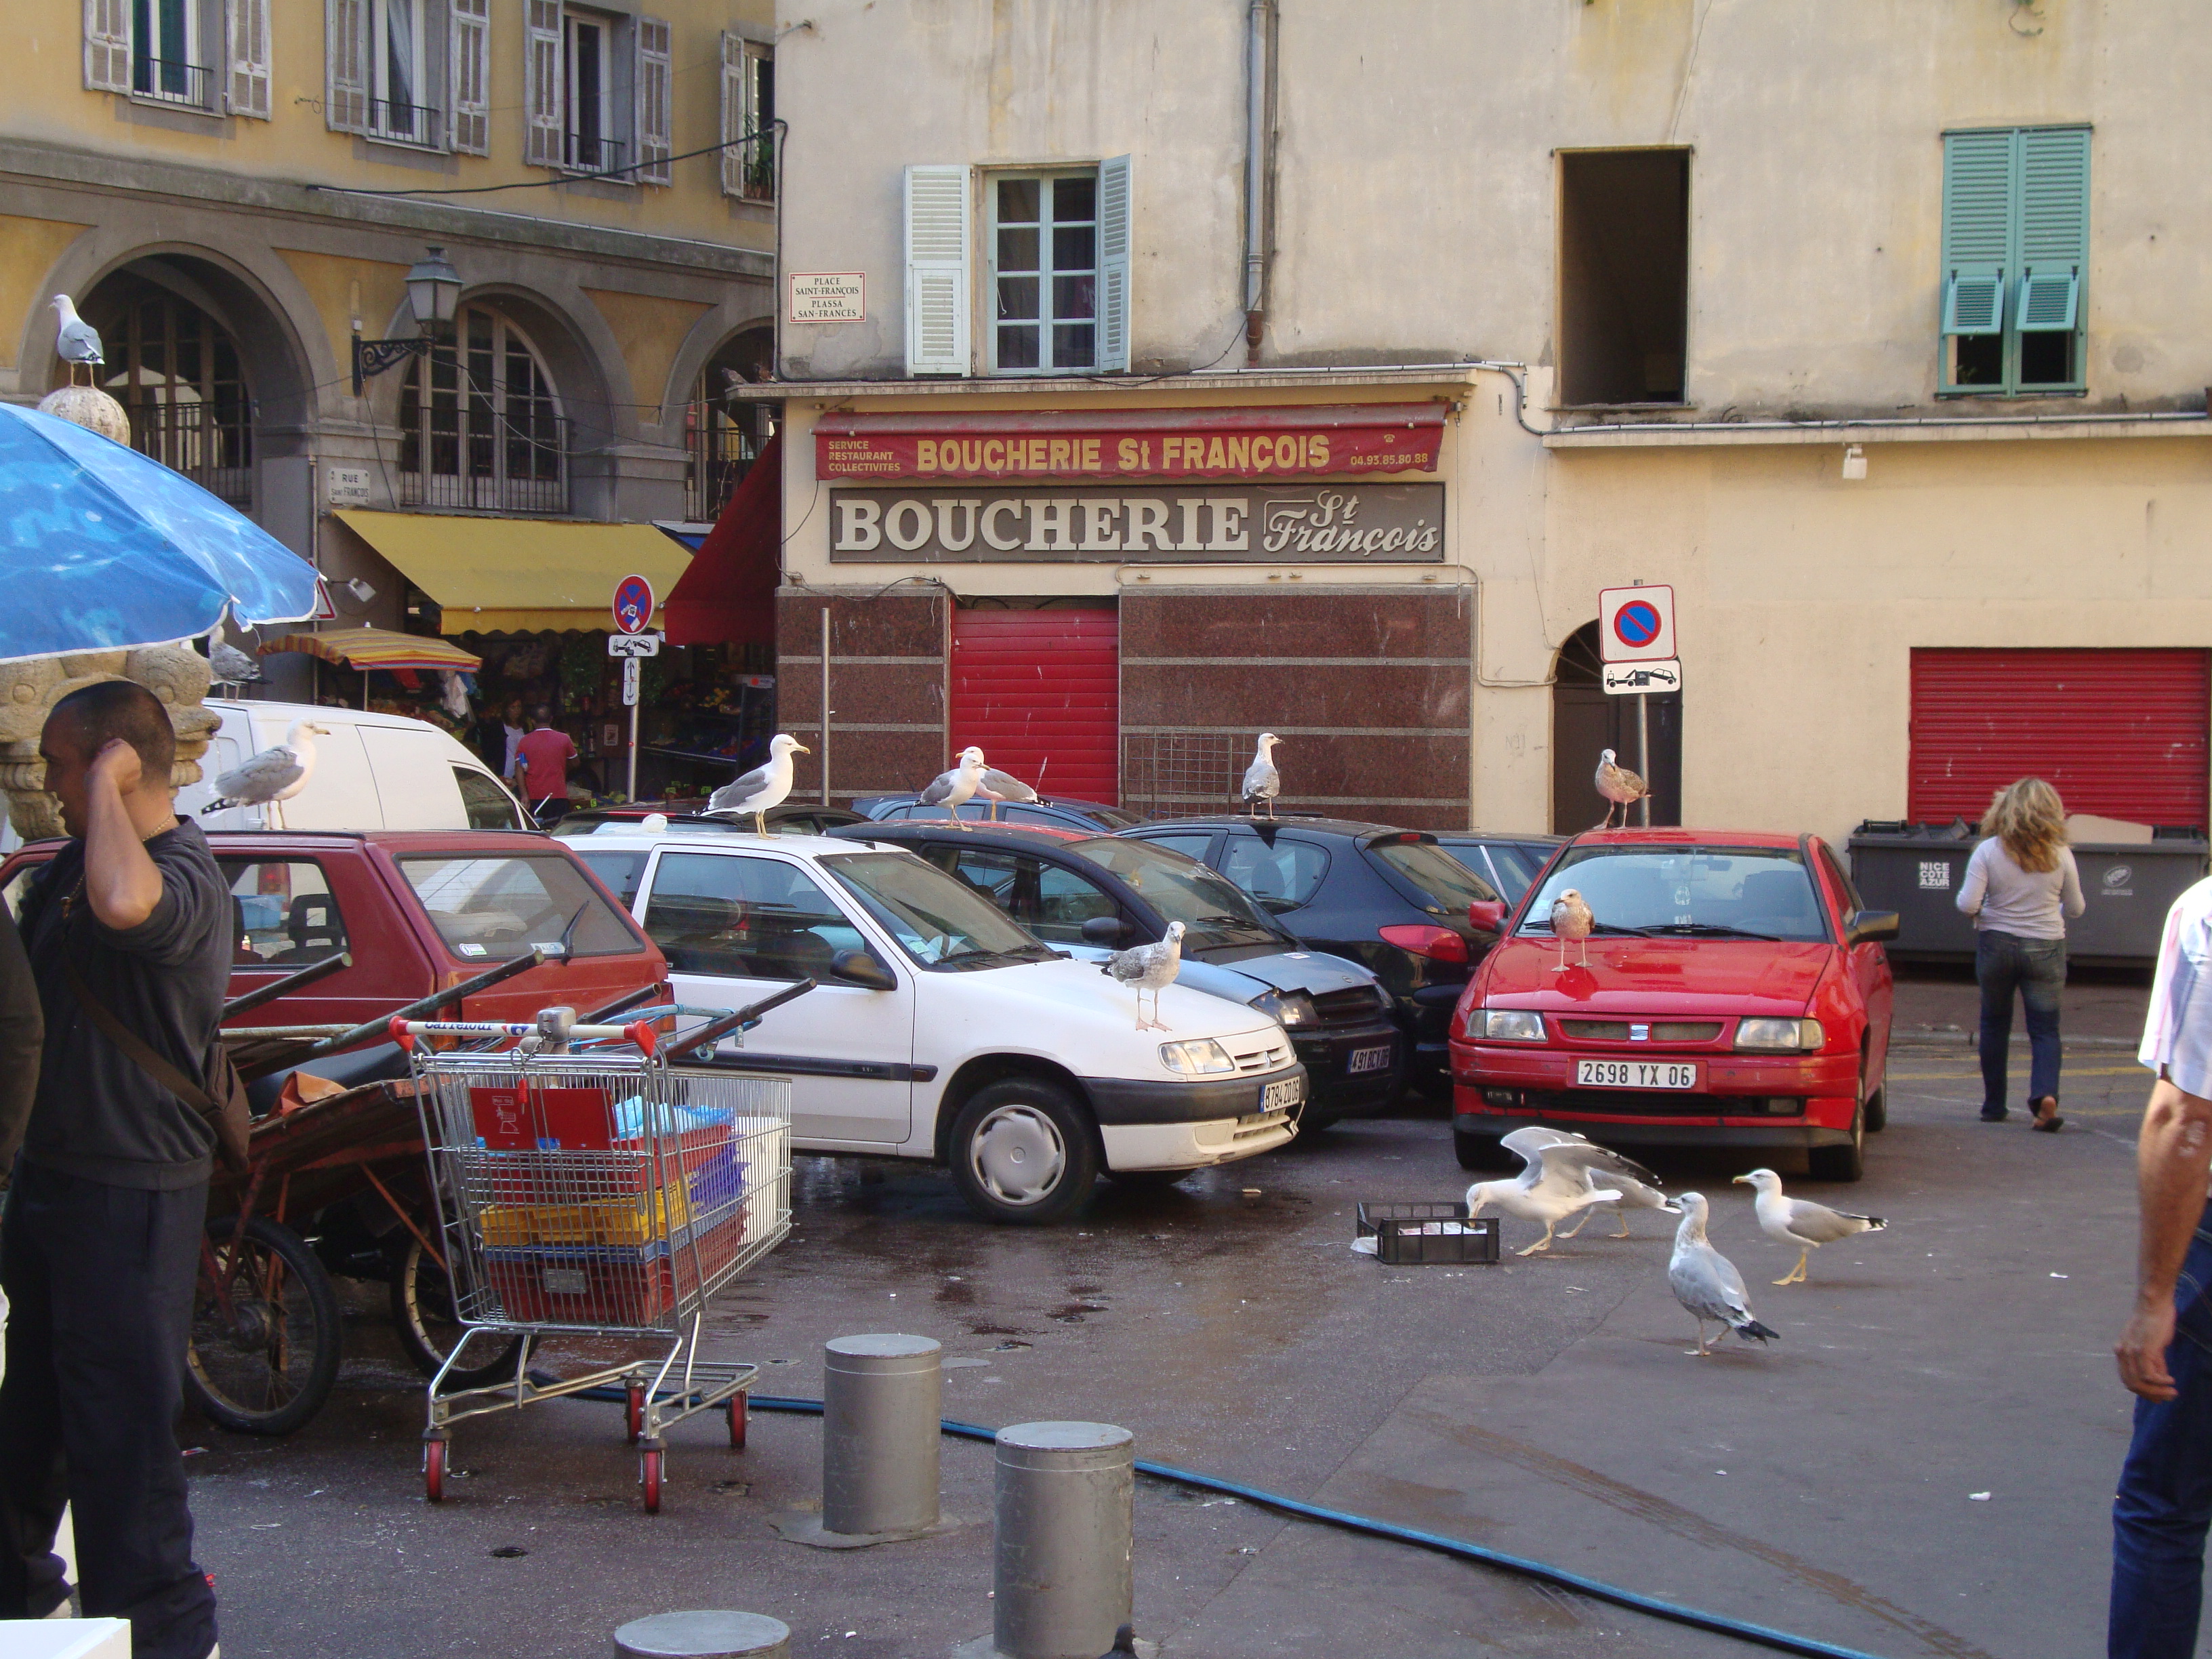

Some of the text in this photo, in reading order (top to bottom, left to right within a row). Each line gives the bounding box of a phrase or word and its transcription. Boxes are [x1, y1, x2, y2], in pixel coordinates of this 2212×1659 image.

[814, 277, 840, 285] PLACE
[795, 286, 859, 296] SAINT-FRANÇOIS
[812, 300, 843, 308] PLASSA
[798, 308, 857, 318] SAN-FRANCÈS
[828, 441, 869, 450] SERVICE
[828, 451, 894, 461] RESTAURANT
[917, 434, 1330, 473] BOUCHERIE St FRANÇOIS
[1350, 452, 1429, 466] 04.93.85.80.88
[828, 462, 901, 472] COLLECTIVITES
[342, 473, 359, 483] RUE
[834, 489, 1360, 552] BOUCHERIE St
[1263, 508, 1439, 556] François
[1919, 861, 1950, 871] NICE
[1919, 870, 1950, 879] COTE
[1919, 878, 1950, 886] AZUR
[1352, 1051, 1367, 1069] 491
[1583, 1063, 1690, 1086] 2698 YX 06
[1265, 1084, 1283, 1109] 8784
